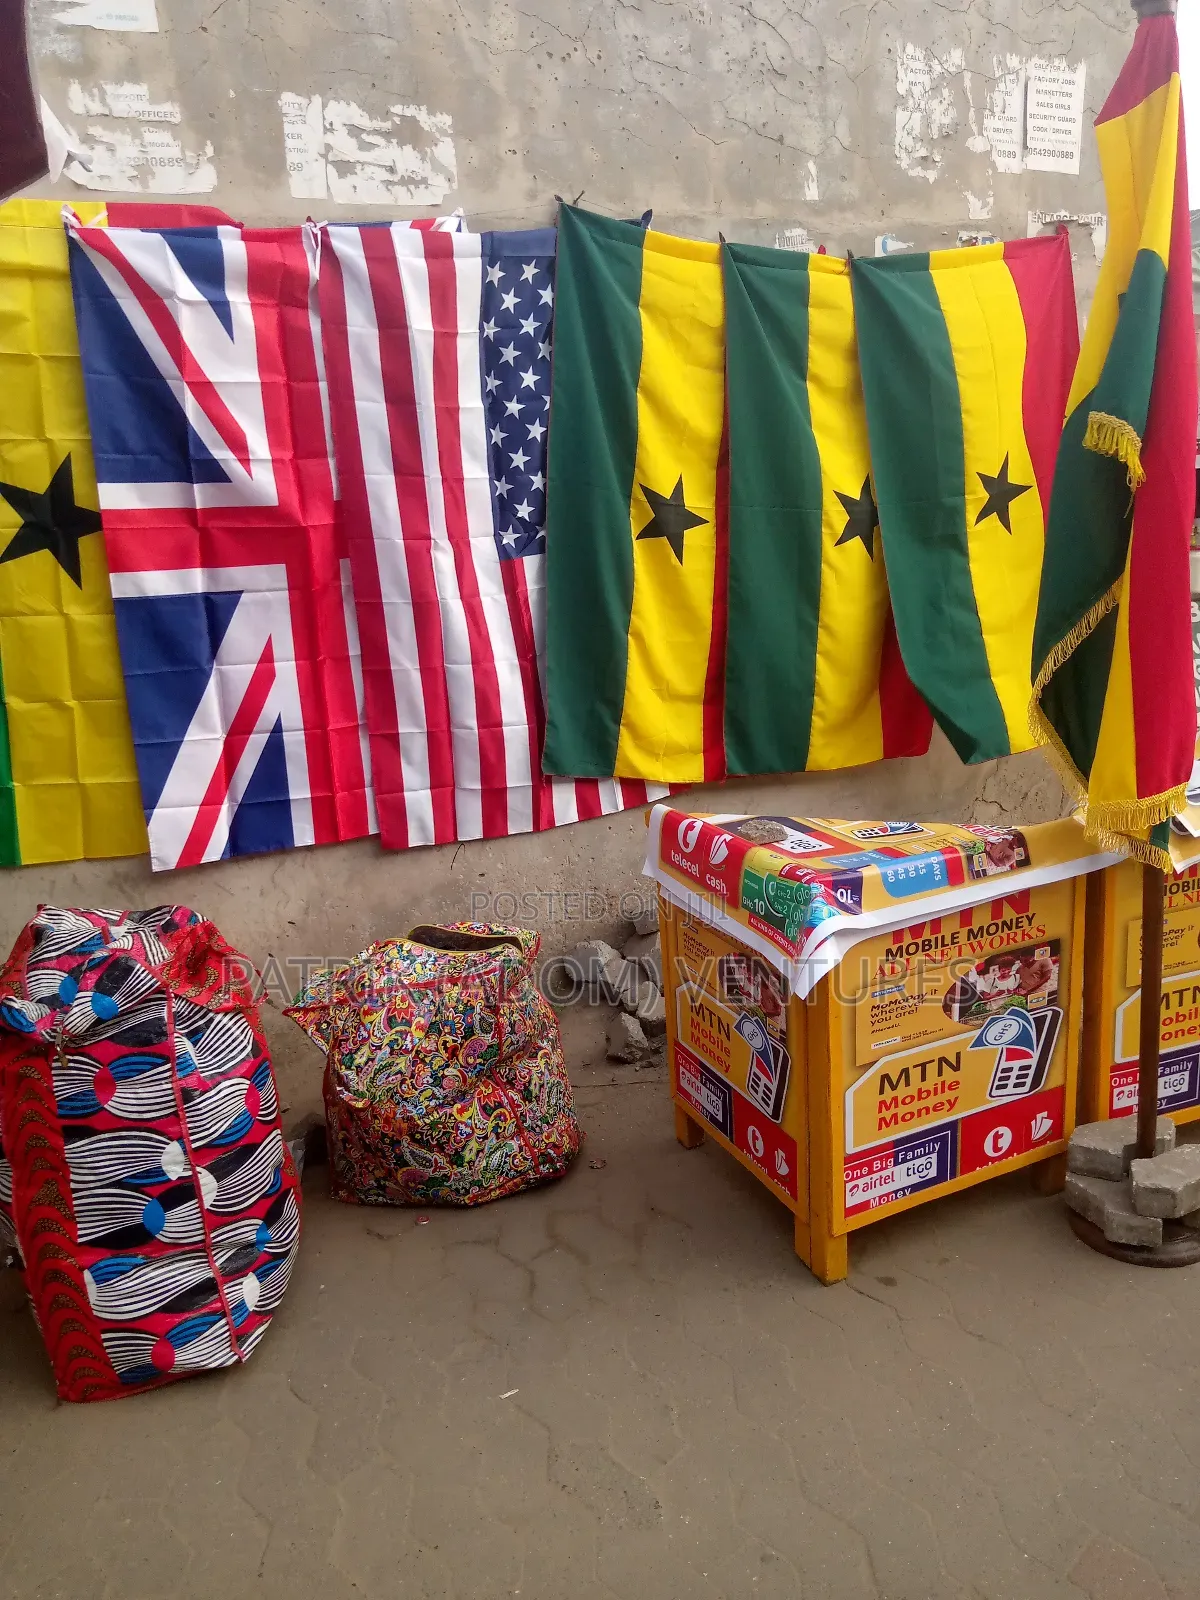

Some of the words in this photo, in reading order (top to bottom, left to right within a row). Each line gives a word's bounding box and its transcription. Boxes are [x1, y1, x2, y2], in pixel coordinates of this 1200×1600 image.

[1035, 89, 1073, 98] MARKETTERS
[1036, 101, 1054, 109] SALES
[1028, 113, 1057, 122] SECURITY
[1057, 115, 1077, 124] GUARD
[1052, 128, 1072, 136] DRIVER
[997, 149, 1017, 159] 0889
[1028, 147, 1074, 160] 0542900889
[671, 849, 700, 878] telecel
[897, 867, 906, 880] 45
[907, 866, 916, 878] 30
[917, 862, 927, 875] 15
[930, 856, 942, 881] DAYS
[705, 873, 727, 896] cash
[886, 870, 896, 883] 60
[754, 898, 766, 916] 10
[885, 931, 961, 962] MOBILE
[966, 913, 1037, 942] MONEY
[873, 957, 918, 981] ALL
[922, 923, 1047, 967] NETWORKS
[870, 992, 928, 1012] MoMoPay
[930, 988, 938, 996] it
[870, 999, 926, 1019] wherever
[690, 996, 731, 1042] MTN
[870, 1016, 892, 1027] you
[894, 1007, 918, 1019] are!
[690, 1016, 731, 1058] Mobile
[993, 1022, 1013, 1042] GHS
[690, 1032, 731, 1074] Money
[878, 1051, 962, 1096] MTN
[1111, 1077, 1133, 1087] One
[1158, 1060, 1193, 1076] Family
[702, 1076, 724, 1101] Family
[876, 1079, 961, 1114] Mobile
[876, 1096, 960, 1132] Money
[844, 1164, 869, 1181] One
[873, 1154, 894, 1172] Big
[898, 1140, 941, 1163] Family
[862, 1170, 896, 1193] airtel
[870, 1186, 912, 1209] Money
